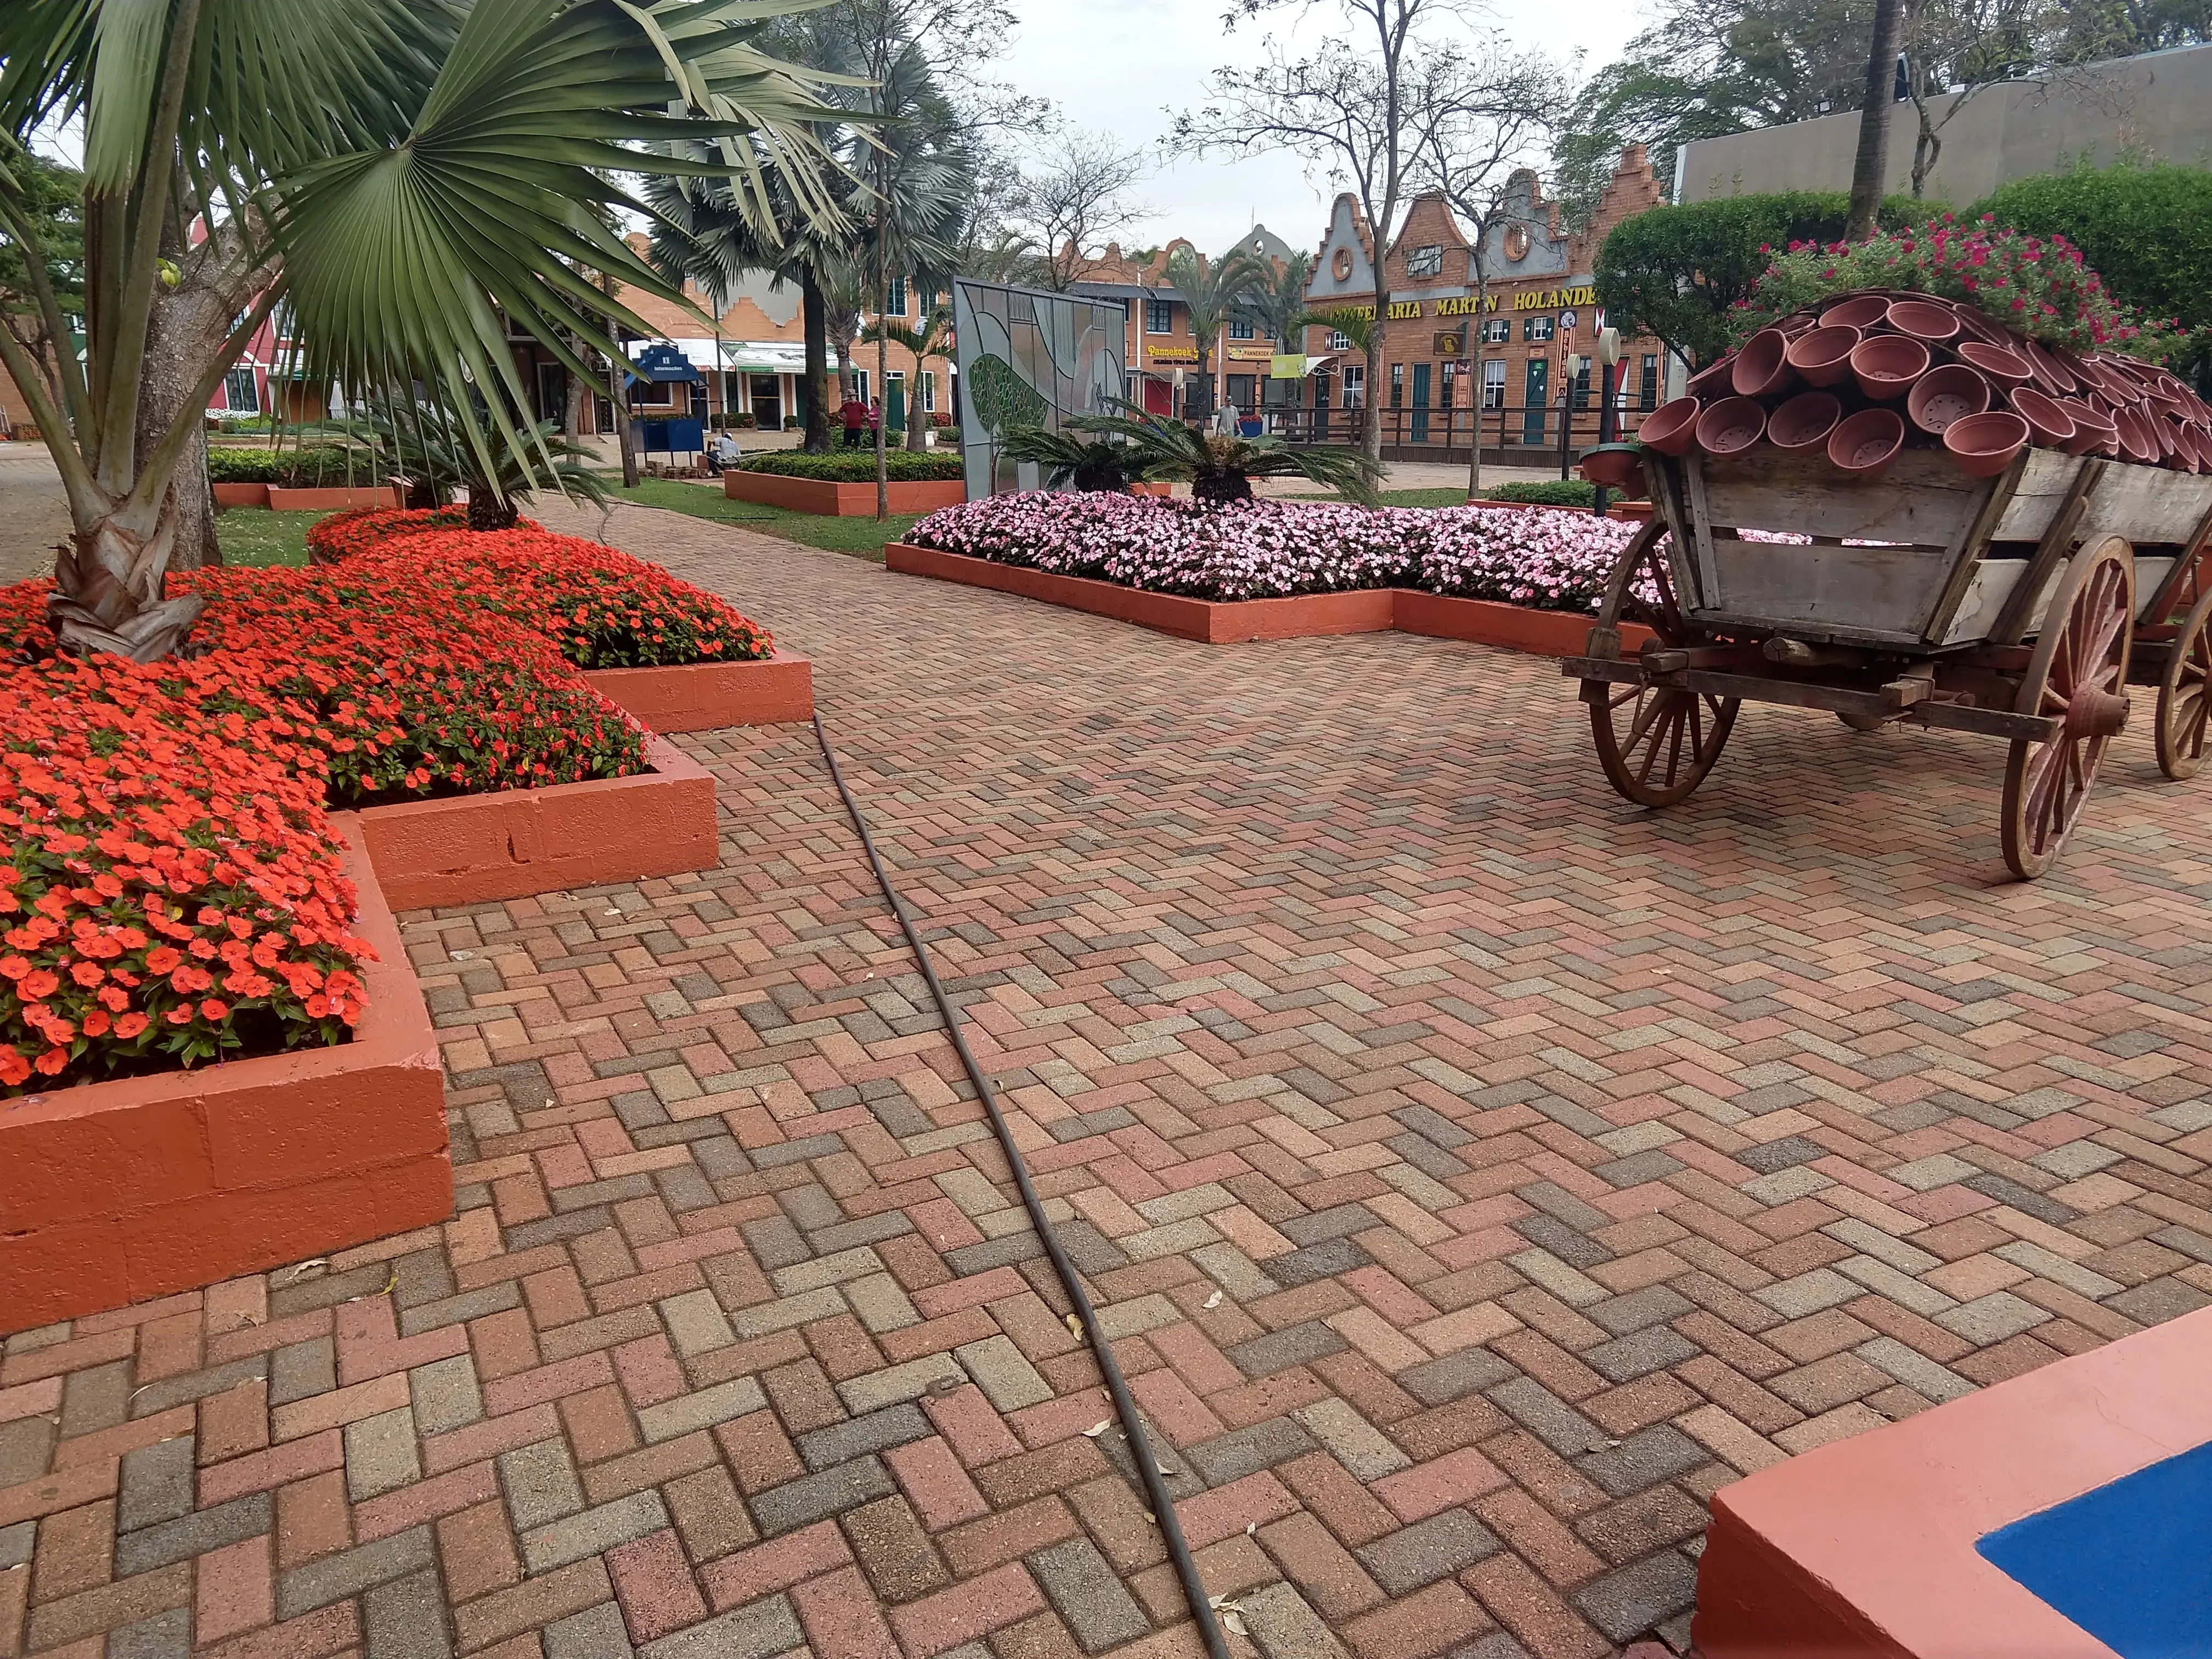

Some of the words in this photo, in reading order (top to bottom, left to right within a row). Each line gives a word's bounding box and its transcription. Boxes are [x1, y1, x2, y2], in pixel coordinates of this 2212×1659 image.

[1435, 295, 1499, 315] MARTN
[1514, 286, 1596, 310] HOLANDE
[1148, 345, 1192, 357] Pannekoek
[1561, 330, 1569, 377] Bebidas
